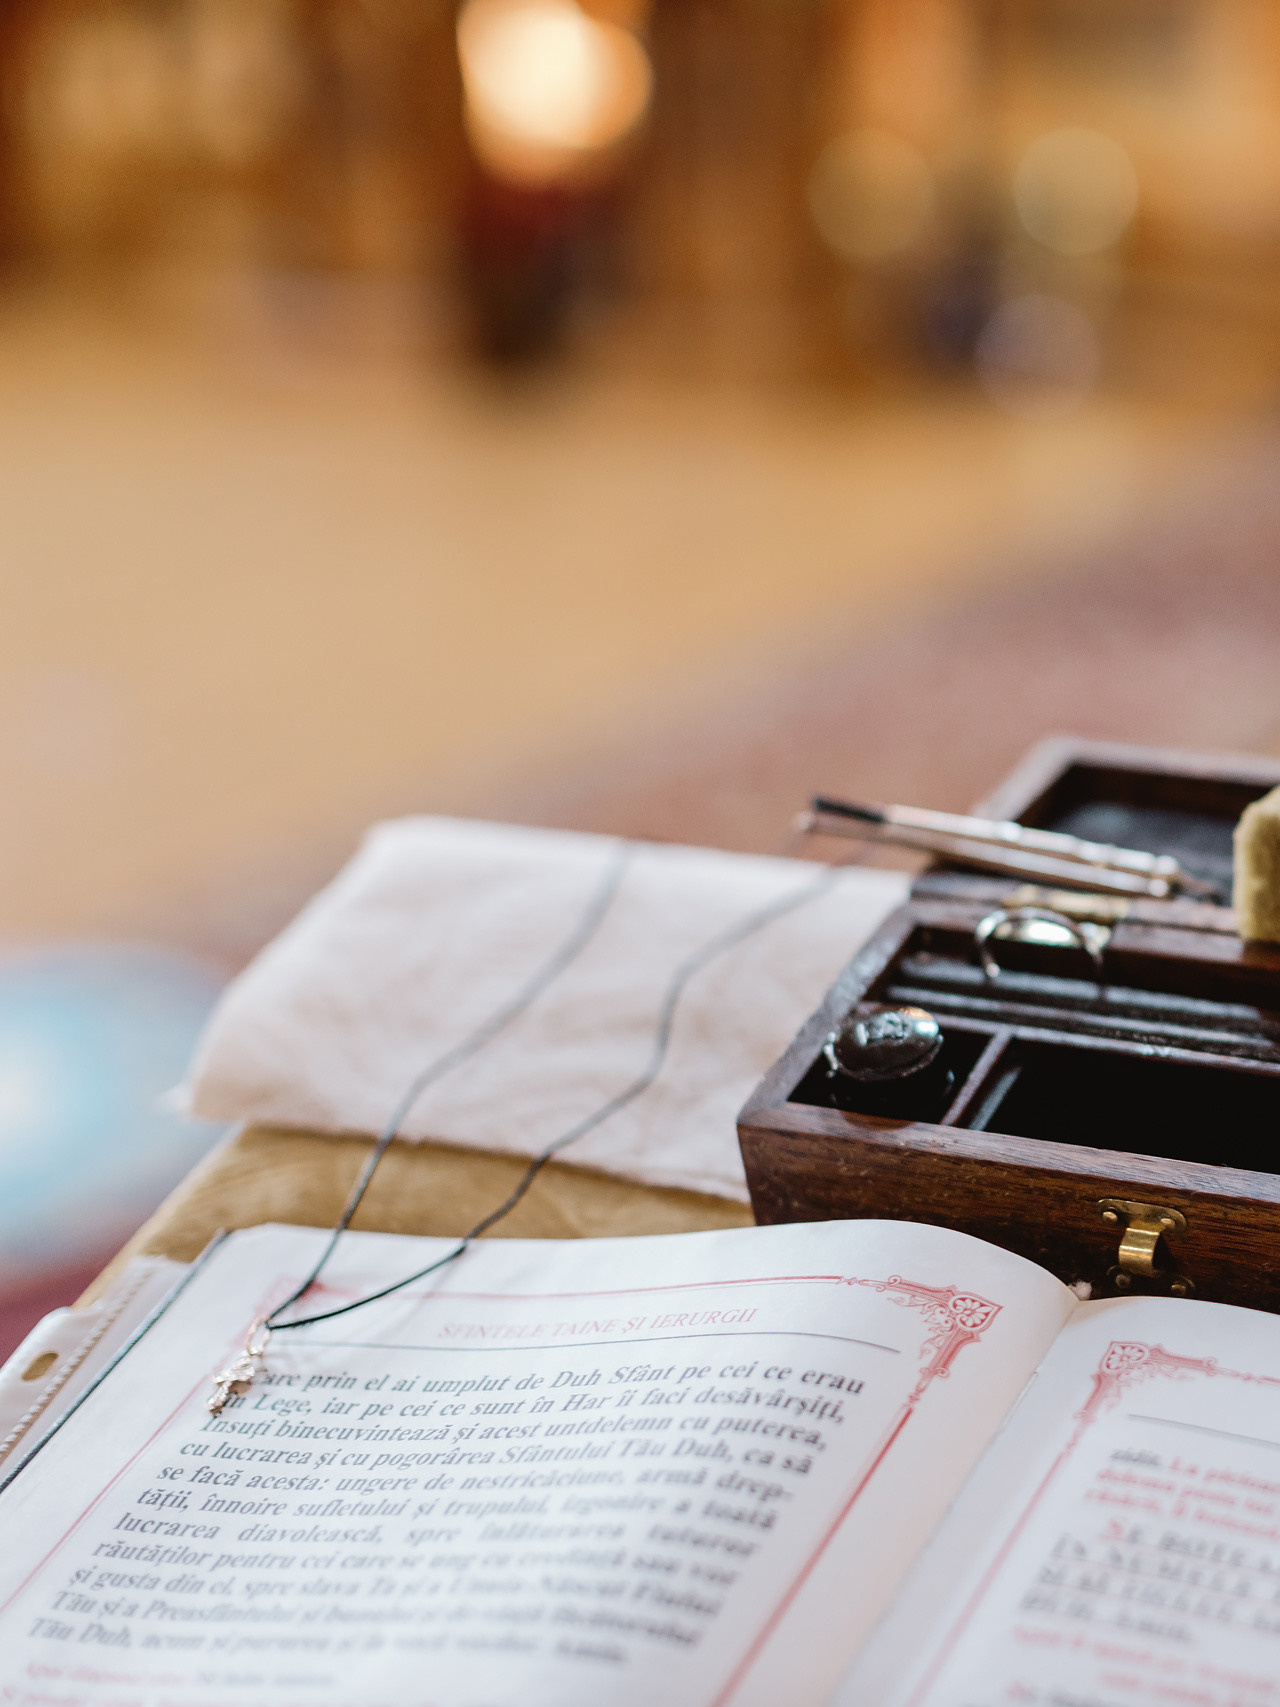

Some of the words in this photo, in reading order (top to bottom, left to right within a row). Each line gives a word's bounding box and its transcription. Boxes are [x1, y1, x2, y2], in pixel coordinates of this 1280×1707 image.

[437, 1321, 549, 1340] SFINTELE
[552, 1318, 619, 1338] TAINE
[650, 1308, 759, 1329] IERURGII
[301, 1371, 357, 1392] prin
[365, 1374, 390, 1391] el
[391, 1375, 420, 1392] ai
[422, 1374, 510, 1397] umplut
[514, 1373, 545, 1390] de
[549, 1368, 602, 1389] Duh
[607, 1363, 676, 1385] Sfânt
[676, 1363, 712, 1385] pe
[718, 1361, 760, 1380] cei
[763, 1366, 793, 1380] ce
[800, 1369, 866, 1396] erau
[251, 1393, 313, 1417] Lege,
[320, 1398, 361, 1415] iar
[359, 1402, 394, 1420] pe
[399, 1401, 438, 1418] cei
[439, 1402, 466, 1417] ce
[470, 1399, 523, 1416] sunt
[527, 1395, 554, 1413] în
[559, 1392, 613, 1412] Har
[639, 1386, 692, 1407] faci
[273, 1418, 452, 1442] binecuvintează
[451, 1423, 481, 1444] și
[477, 1423, 544, 1440] acest
[543, 1414, 675, 1438] untdelemn
[678, 1416, 711, 1432] cu
[712, 1416, 829, 1451] puterea,
[179, 1441, 211, 1457] cu
[209, 1440, 314, 1466] lucrarea
[312, 1448, 343, 1470] și
[340, 1451, 370, 1467] cu
[367, 1447, 496, 1472] pogorârea
[498, 1439, 618, 1465] Sfântului
[619, 1438, 666, 1458] Tău
[670, 1437, 736, 1462] Duh,
[742, 1448, 777, 1466] ca
[782, 1455, 815, 1476] să
[156, 1465, 184, 1481] se
[187, 1465, 244, 1488] facă
[244, 1472, 331, 1492] acesta:
[334, 1476, 420, 1496] ungere
[422, 1473, 456, 1491] de
[197, 1493, 288, 1517] înnoire
[291, 1497, 411, 1518] sufletului
[113, 1511, 222, 1540] lucrarea
[236, 1522, 384, 1544] diavolească,
[207, 1550, 298, 1573] pentru
[89, 1570, 163, 1593] gusta
[163, 1573, 207, 1595] din
[49, 1590, 98, 1614] Tău
